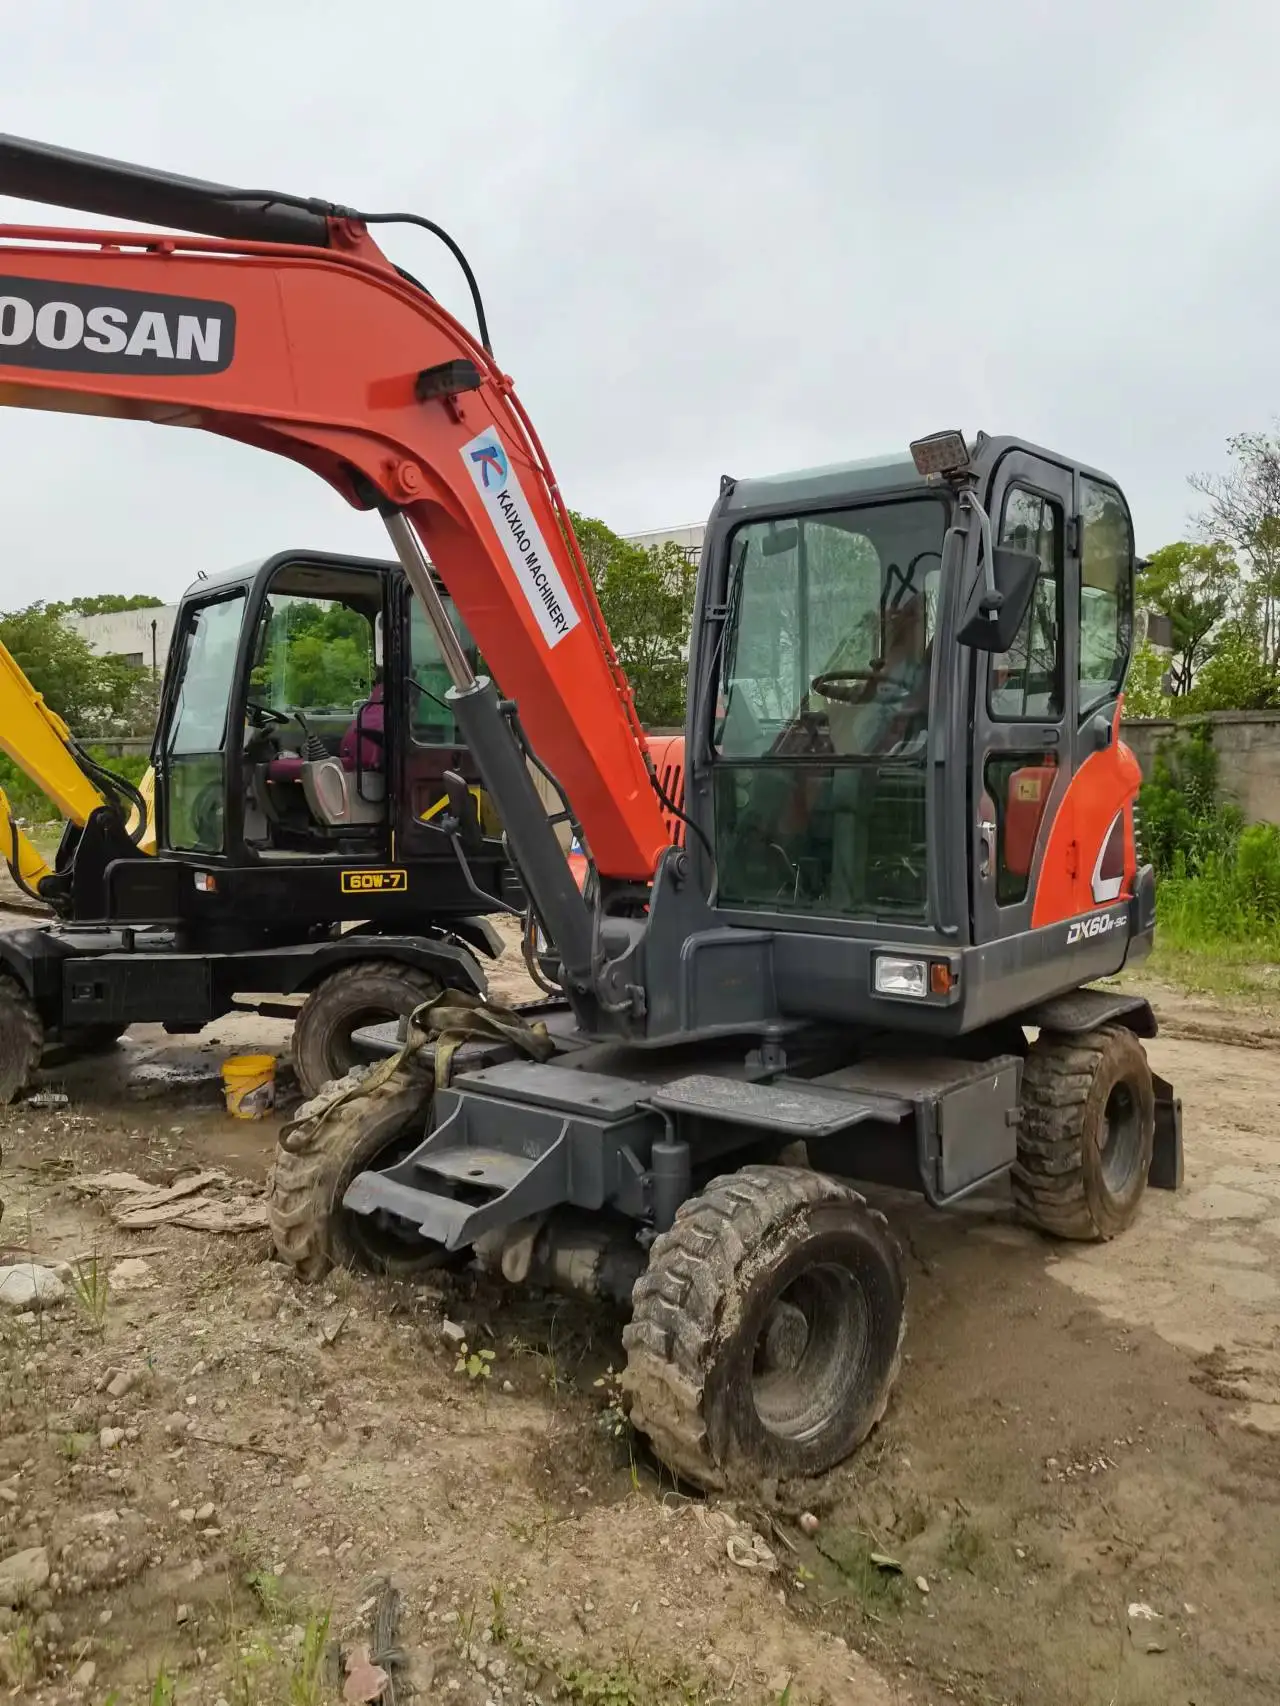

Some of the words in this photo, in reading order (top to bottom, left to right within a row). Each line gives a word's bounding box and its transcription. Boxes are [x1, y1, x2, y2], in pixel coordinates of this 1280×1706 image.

[0, 296, 222, 362] OOSAN
[496, 489, 531, 552] KAIXIAO
[525, 552, 569, 635] MACHINERY
[350, 874, 401, 889] 60W-7
